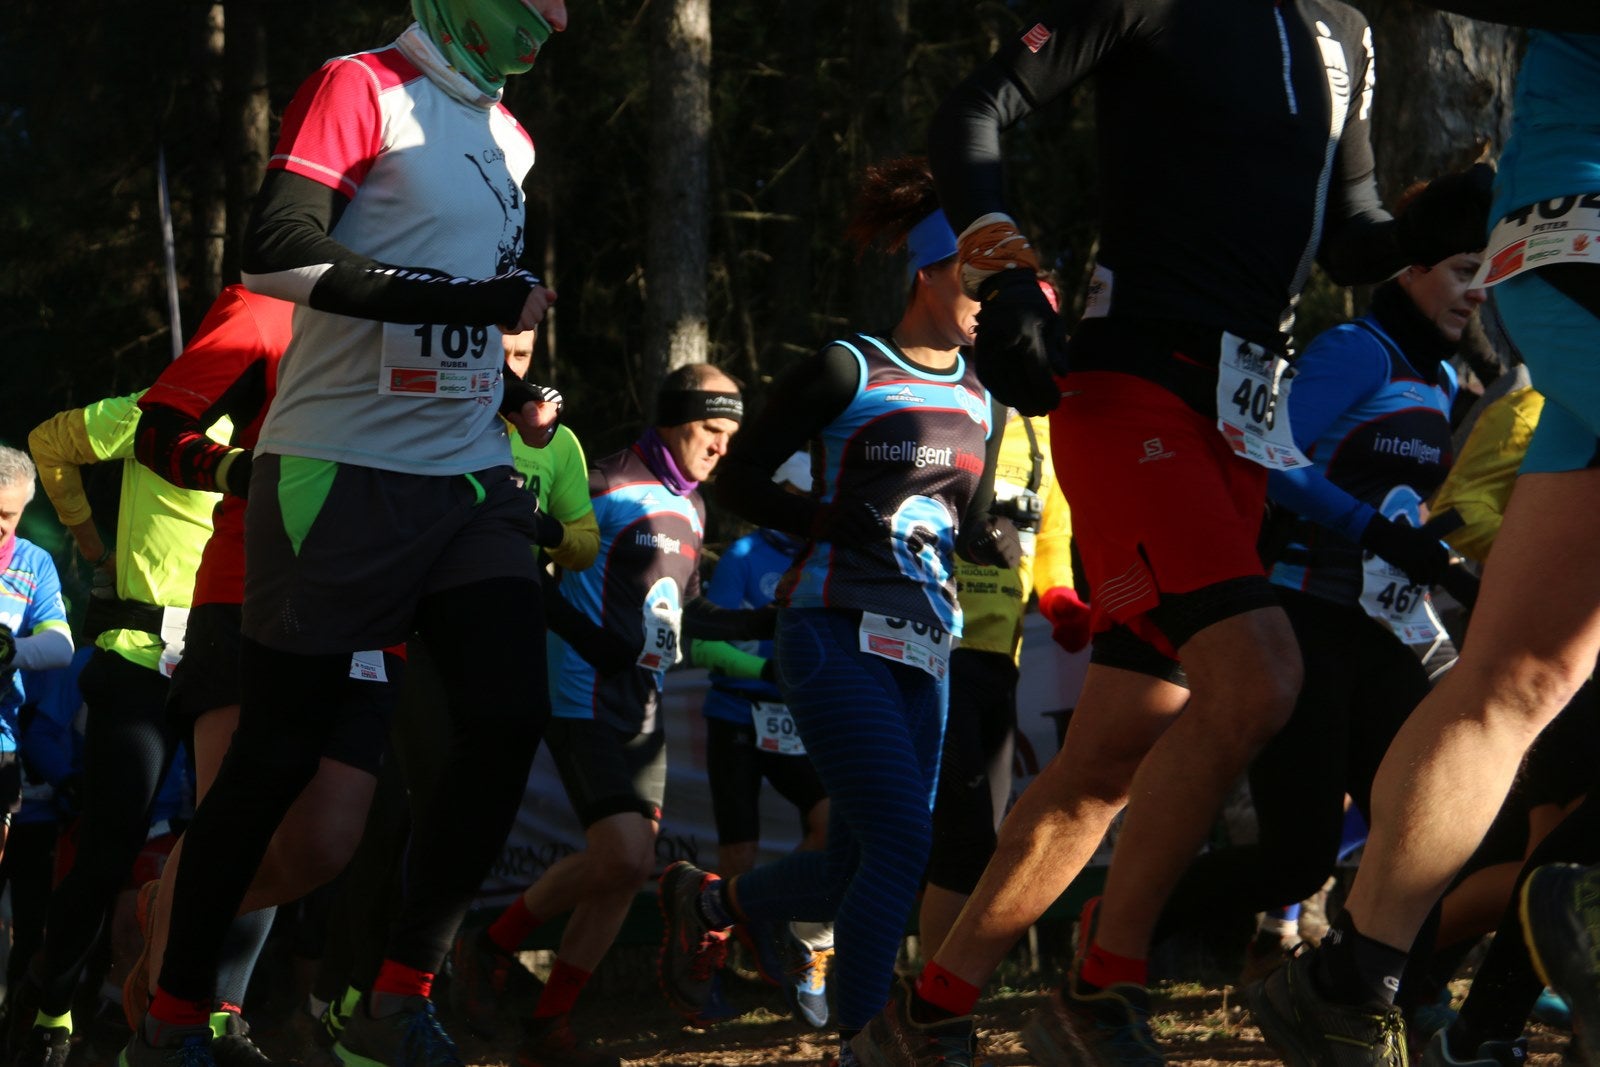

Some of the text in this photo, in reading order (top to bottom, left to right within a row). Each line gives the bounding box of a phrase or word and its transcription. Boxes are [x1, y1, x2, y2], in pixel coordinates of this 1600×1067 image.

[1533, 220, 1569, 232] PETER
[414, 322, 488, 359] 109
[865, 441, 952, 468] intelligent
[1373, 432, 1441, 464] intelligent
[635, 530, 680, 555] intelligent
